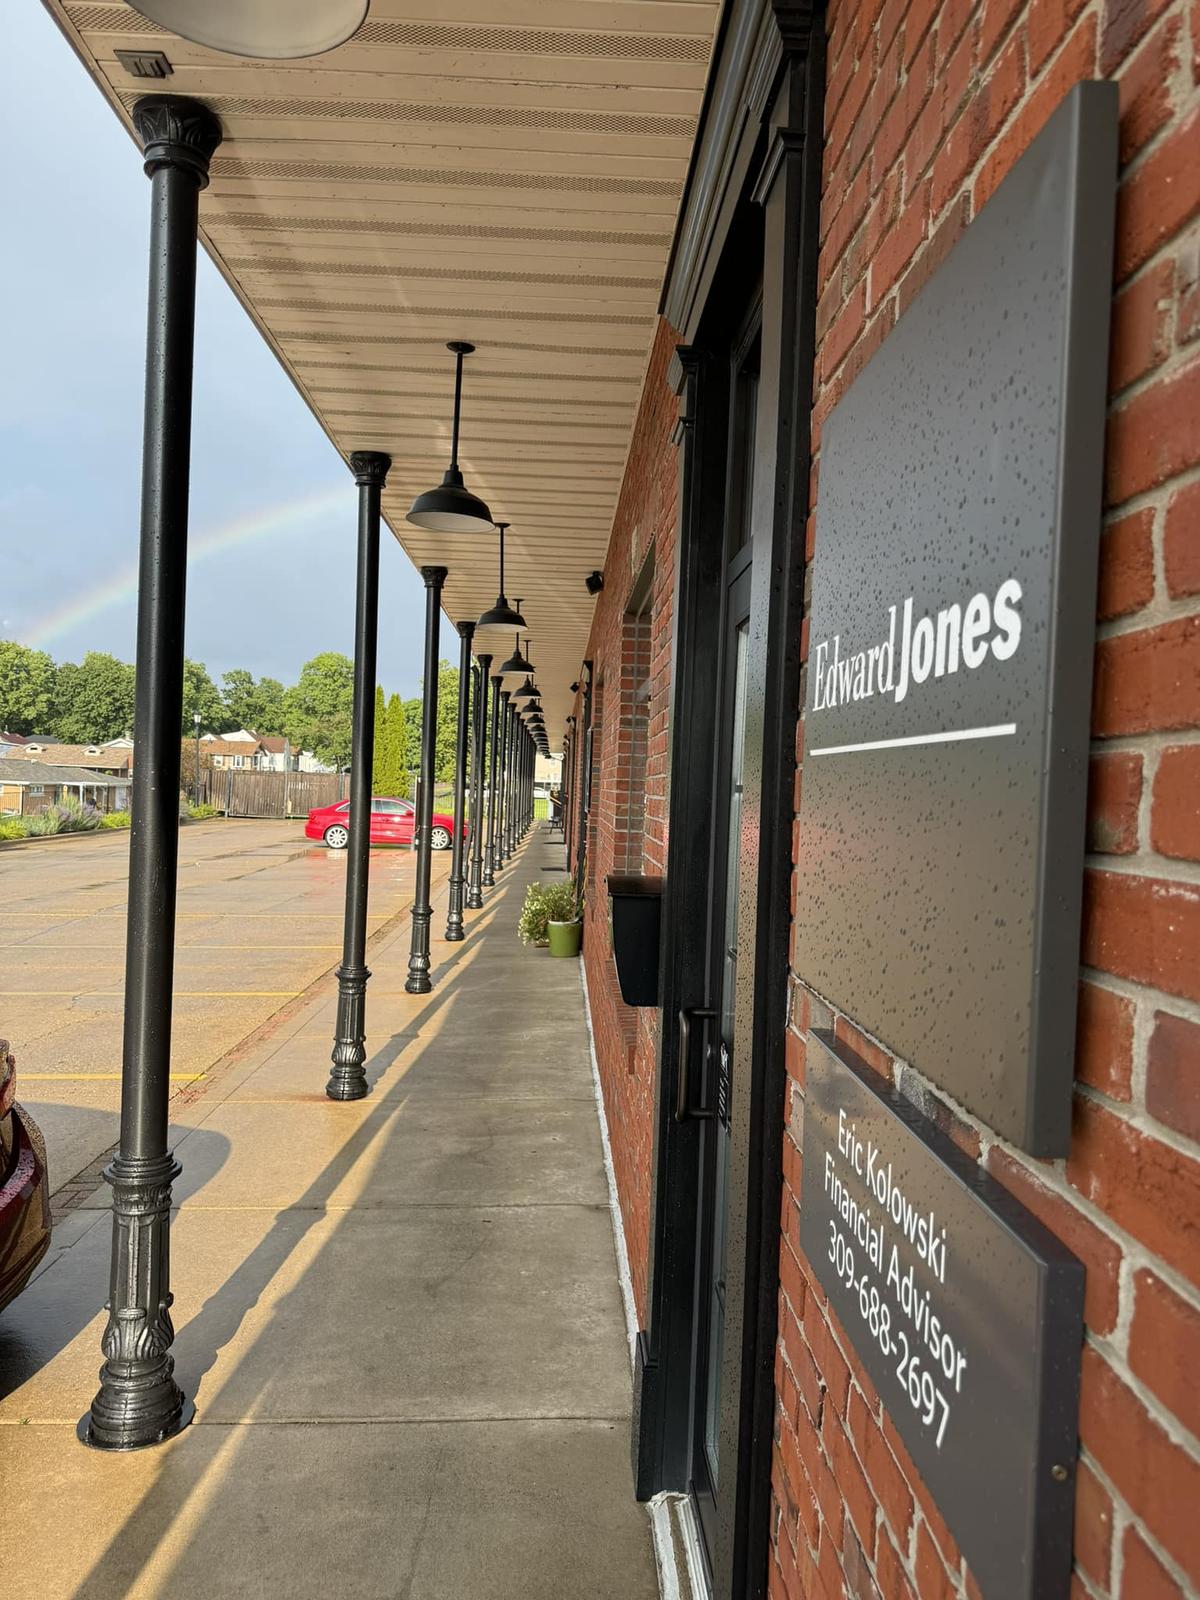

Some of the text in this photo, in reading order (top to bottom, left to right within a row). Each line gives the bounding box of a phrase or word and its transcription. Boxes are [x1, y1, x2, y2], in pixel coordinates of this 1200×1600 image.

[824, 1152, 966, 1393] Financial Advisor
[838, 1108, 947, 1283] Eric Kolowski
[828, 1220, 950, 1449] 309-688-2697
